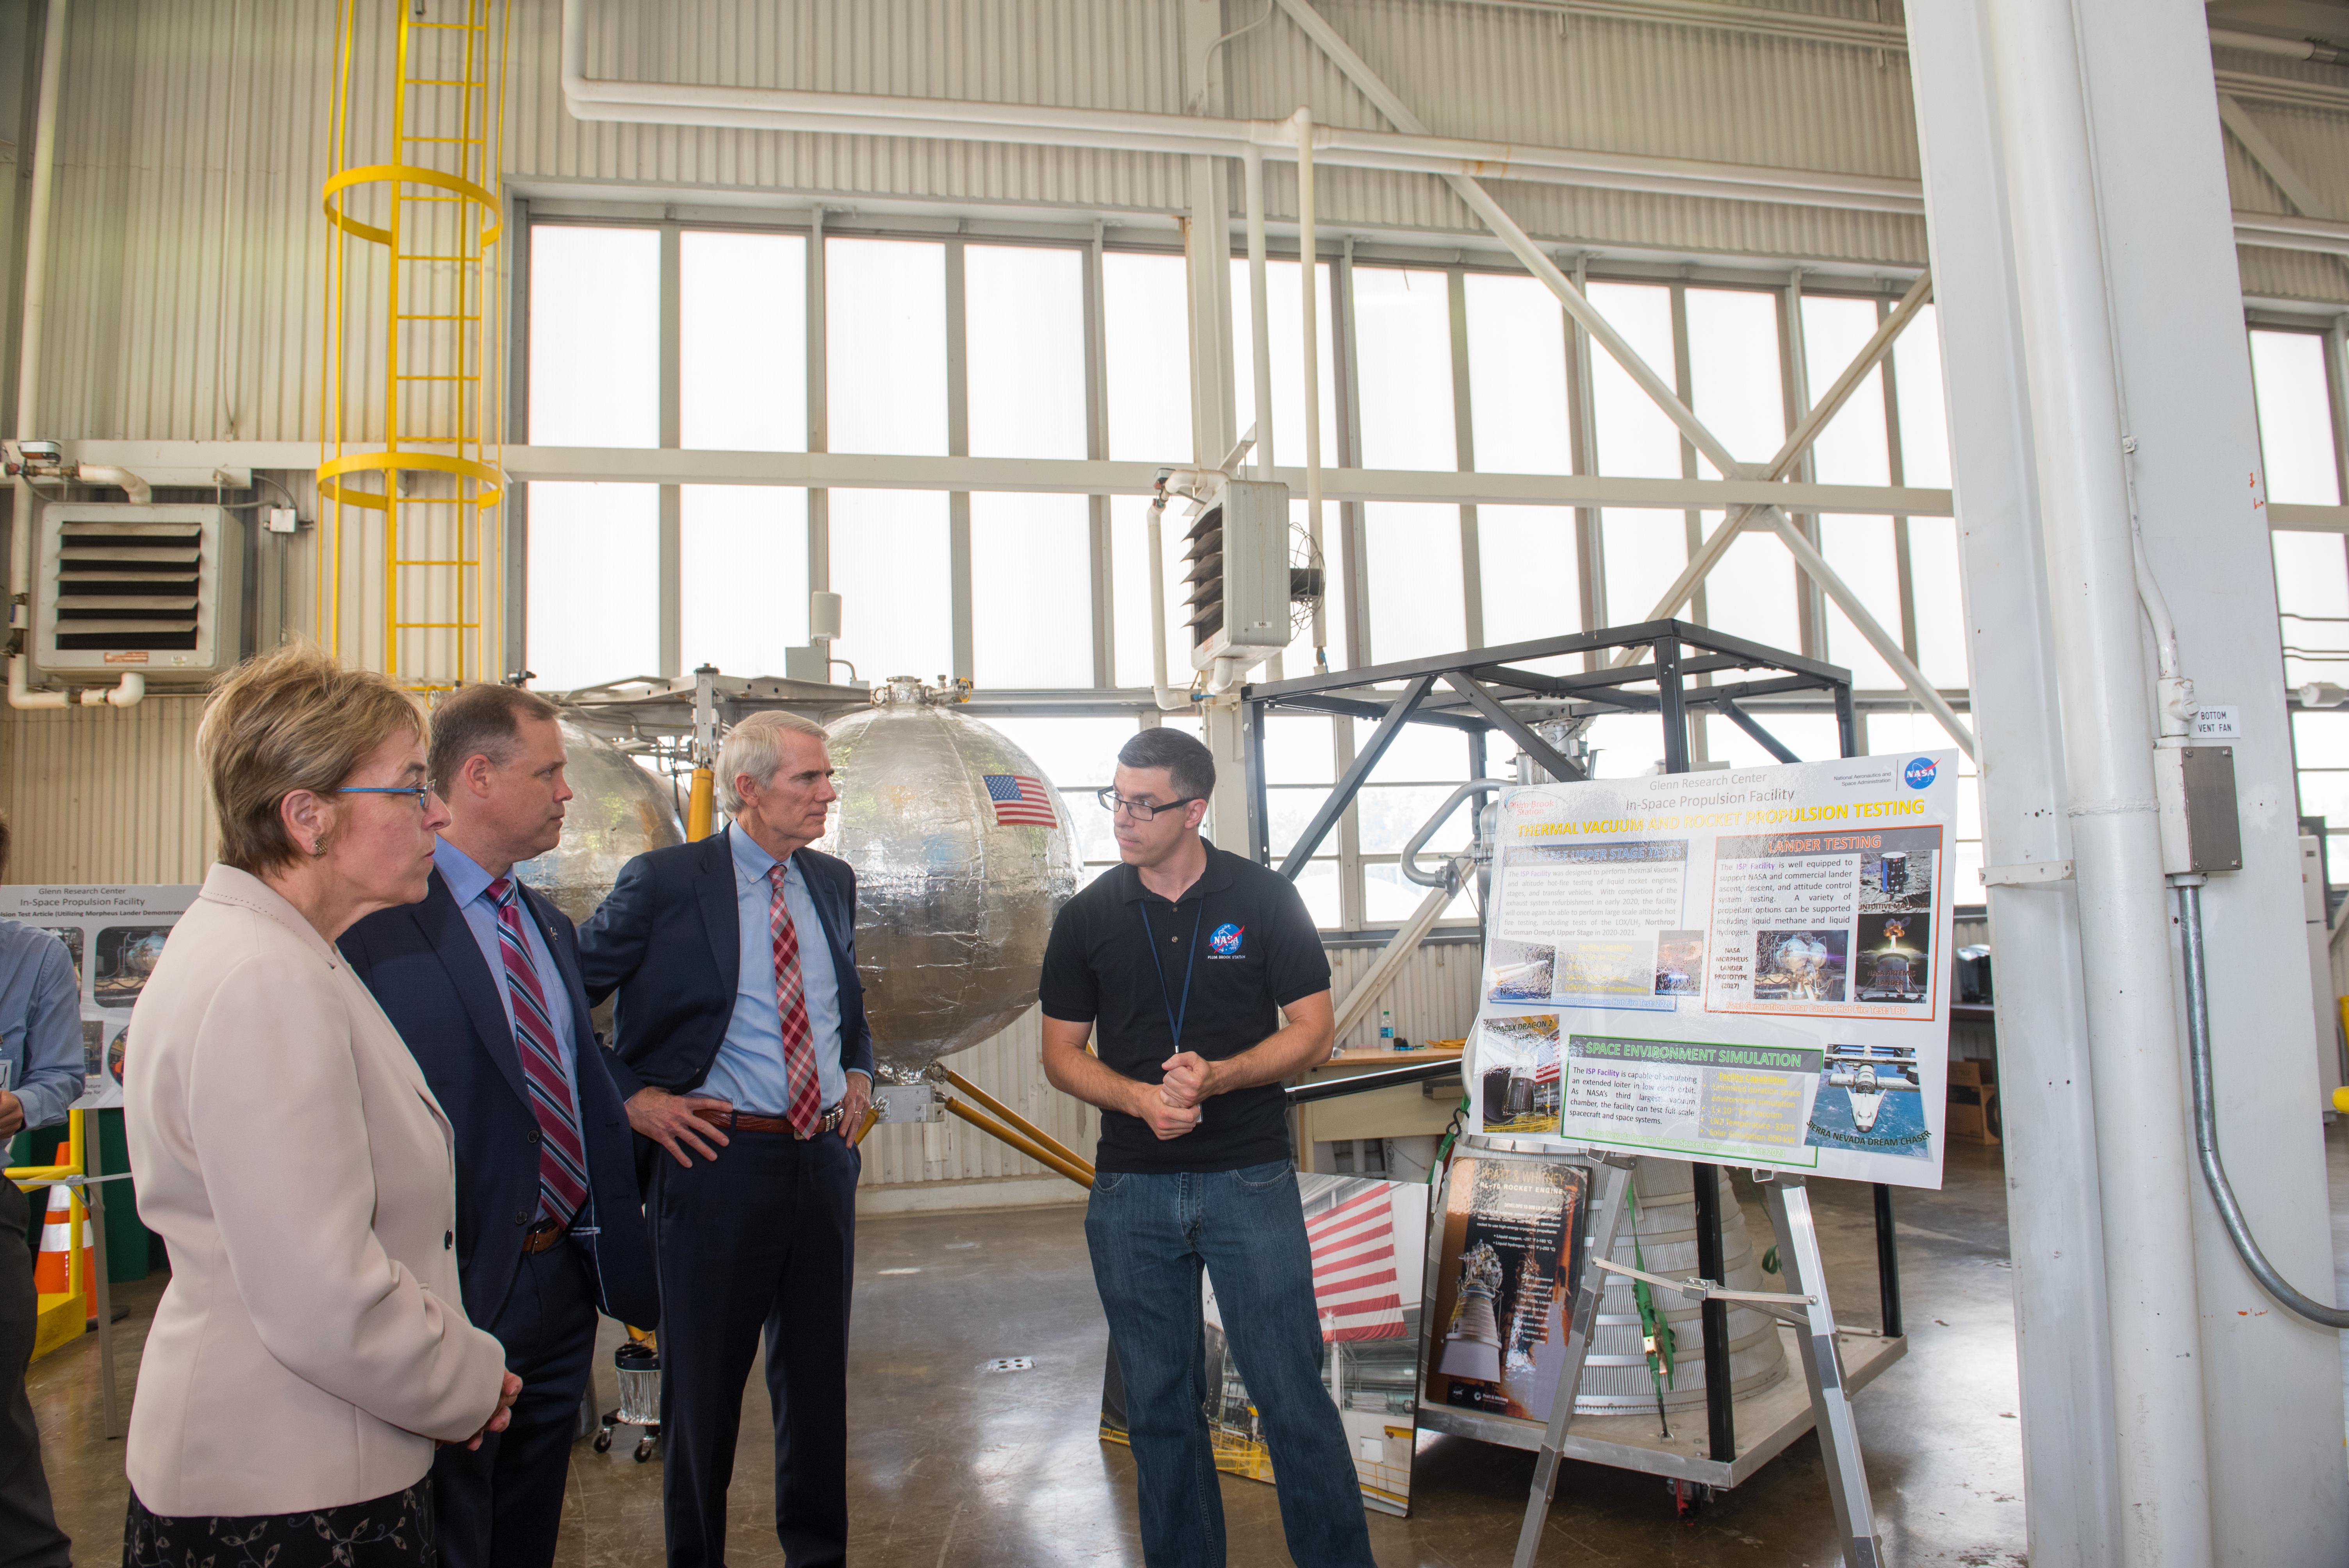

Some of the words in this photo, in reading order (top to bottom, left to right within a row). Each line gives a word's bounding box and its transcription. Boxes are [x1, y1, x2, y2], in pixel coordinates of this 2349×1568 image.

[2201, 711, 2226, 720] BOTTOM
[1907, 769, 1934, 778] NASA
[1650, 781, 1679, 791] Glenn
[1682, 775, 1727, 789] Research
[1732, 773, 1767, 784] Center
[1626, 799, 1675, 812] In-Space
[1680, 793, 1745, 809] Propulsion
[1750, 789, 1795, 802] Facility
[1518, 821, 1578, 837] THERMAL
[1583, 818, 1643, 834] VACUUM
[1648, 816, 1680, 830] AND
[1684, 811, 1741, 828] ROCKET
[1746, 804, 1848, 825] PROPULSION
[1854, 799, 1925, 817] TESTING
[1768, 838, 1820, 853] LANDER
[1824, 835, 1881, 850] TESTING
[1571, 849, 1607, 860] UPPER
[1609, 848, 1645, 859] STAGE
[1648, 846, 1680, 857] TESTS
[1806, 860, 1841, 870] equipped
[114, 898, 145, 906] Facility
[1214, 936, 1239, 944] NASA
[1721, 982, 1739, 990] (2017)
[1551, 996, 1579, 1005] Northrop
[1745, 1001, 1785, 1010] Generation
[1809, 1004, 1836, 1012] Lander
[1870, 1006, 1888, 1014] Test:
[1891, 1006, 1907, 1014] TBD
[1518, 1021, 1547, 1030] DRAGON
[1586, 1042, 1620, 1055] SPACE
[1624, 1044, 1716, 1061] ENVIRONMENT
[1719, 1049, 1801, 1067] SIMULATION
[1583, 1078, 1611, 1087] extended
[1597, 1069, 1619, 1078] Facility
[1628, 1071, 1652, 1080] capable
[1663, 1075, 1697, 1084] simulating
[1639, 1094, 1661, 1103] largest
[1570, 1099, 1598, 1108] chamber,
[1614, 1102, 1634, 1112] facility
[1635, 1116, 1662, 1125] systems.
[1806, 1120, 1830, 1138] SIERRA
[1833, 1132, 1865, 1145] NEVADA
[1868, 1138, 1898, 1146] DREAM
[1900, 1130, 1932, 1145] CHASER
[1586, 1128, 1604, 1137] Sierra
[1606, 1130, 1630, 1139] Nevada
[1632, 1133, 1653, 1143] Dream
[1656, 1136, 1678, 1145] Chaser
[1680, 1139, 1700, 1149] Space
[1702, 1142, 1747, 1153] Environment
[1749, 1146, 1766, 1155] Test:
[1768, 1148, 1786, 1157] 2021
[1481, 1168, 1510, 1181] PRATT
[1513, 1170, 1519, 1182] &
[1523, 1171, 1565, 1185] WHITNEY
